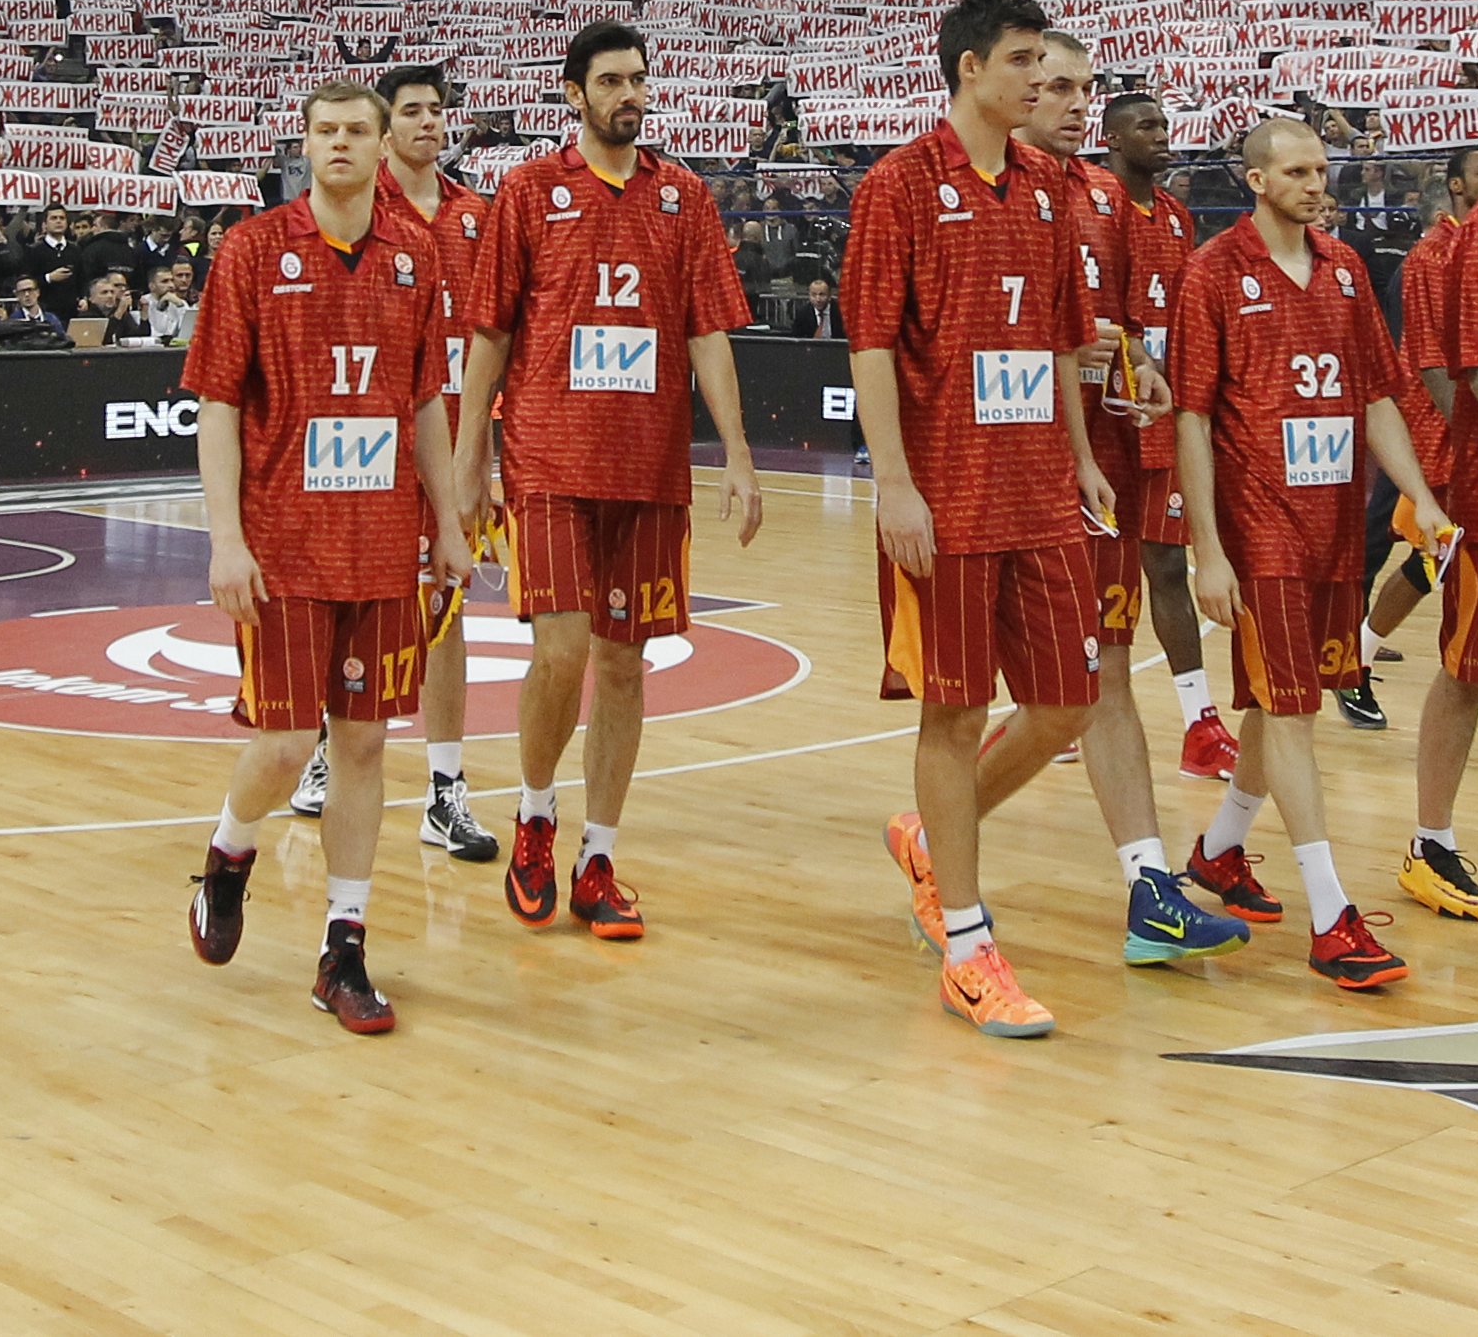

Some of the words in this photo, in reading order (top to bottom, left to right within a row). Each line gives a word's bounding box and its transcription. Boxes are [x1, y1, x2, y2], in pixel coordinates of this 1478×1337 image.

[335, 9, 402, 35] ЖИВИШ
[503, 39, 568, 61] ЖИВИШ
[103, 71, 168, 92] ЖИВИШ
[716, 56, 785, 81] ЖИВИШ
[468, 81, 539, 109] ЖИВИШ
[100, 104, 168, 130] ЖИВИШ
[181, 98, 252, 123] ЖИВИШ
[7, 137, 86, 167] ЖИВИШ
[200, 129, 272, 155] ЖИВИШ
[667, 125, 749, 154] ЖИВИШ
[183, 174, 259, 200] ЖИВИШ
[1080, 244, 1100, 290] 4
[595, 263, 641, 307] 12
[1002, 275, 1025, 325] 7
[574, 328, 652, 371] liv
[330, 345, 377, 395] 17
[573, 376, 653, 391] HOSPITAL
[977, 353, 1050, 401] liv
[1290, 353, 1342, 398] 32
[978, 406, 1052, 421] HOSPITAL
[308, 420, 392, 469] liv
[1286, 420, 1350, 465] liv
[307, 475, 391, 489] HOSPITAL
[1288, 469, 1352, 484] HOSPITAL
[639, 577, 678, 625] 12
[1318, 635, 1358, 676] 32
[382, 646, 416, 702] 17
